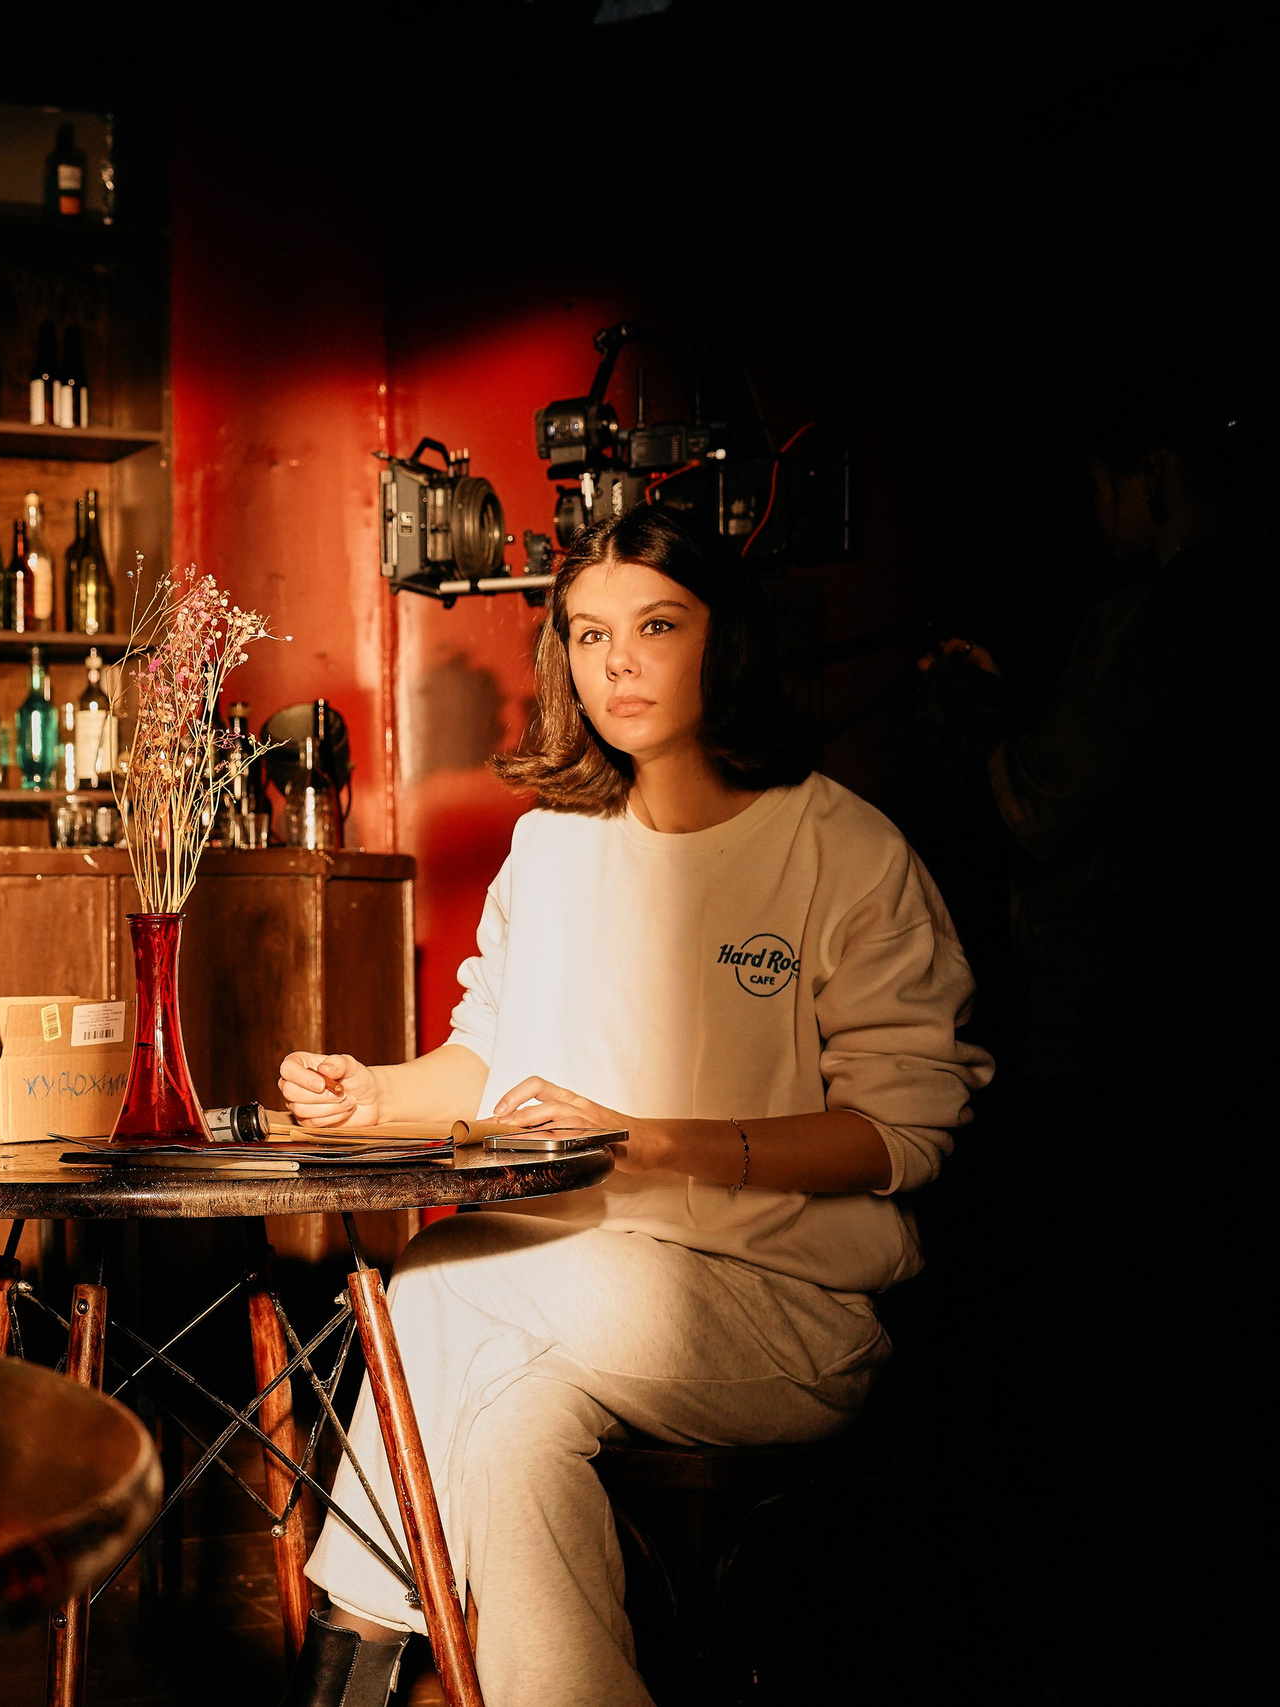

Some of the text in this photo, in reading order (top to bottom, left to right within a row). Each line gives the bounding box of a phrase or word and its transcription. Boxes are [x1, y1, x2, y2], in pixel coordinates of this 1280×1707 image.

[717, 944, 801, 974] Hard Roc
[749, 975, 776, 986] CAFE
